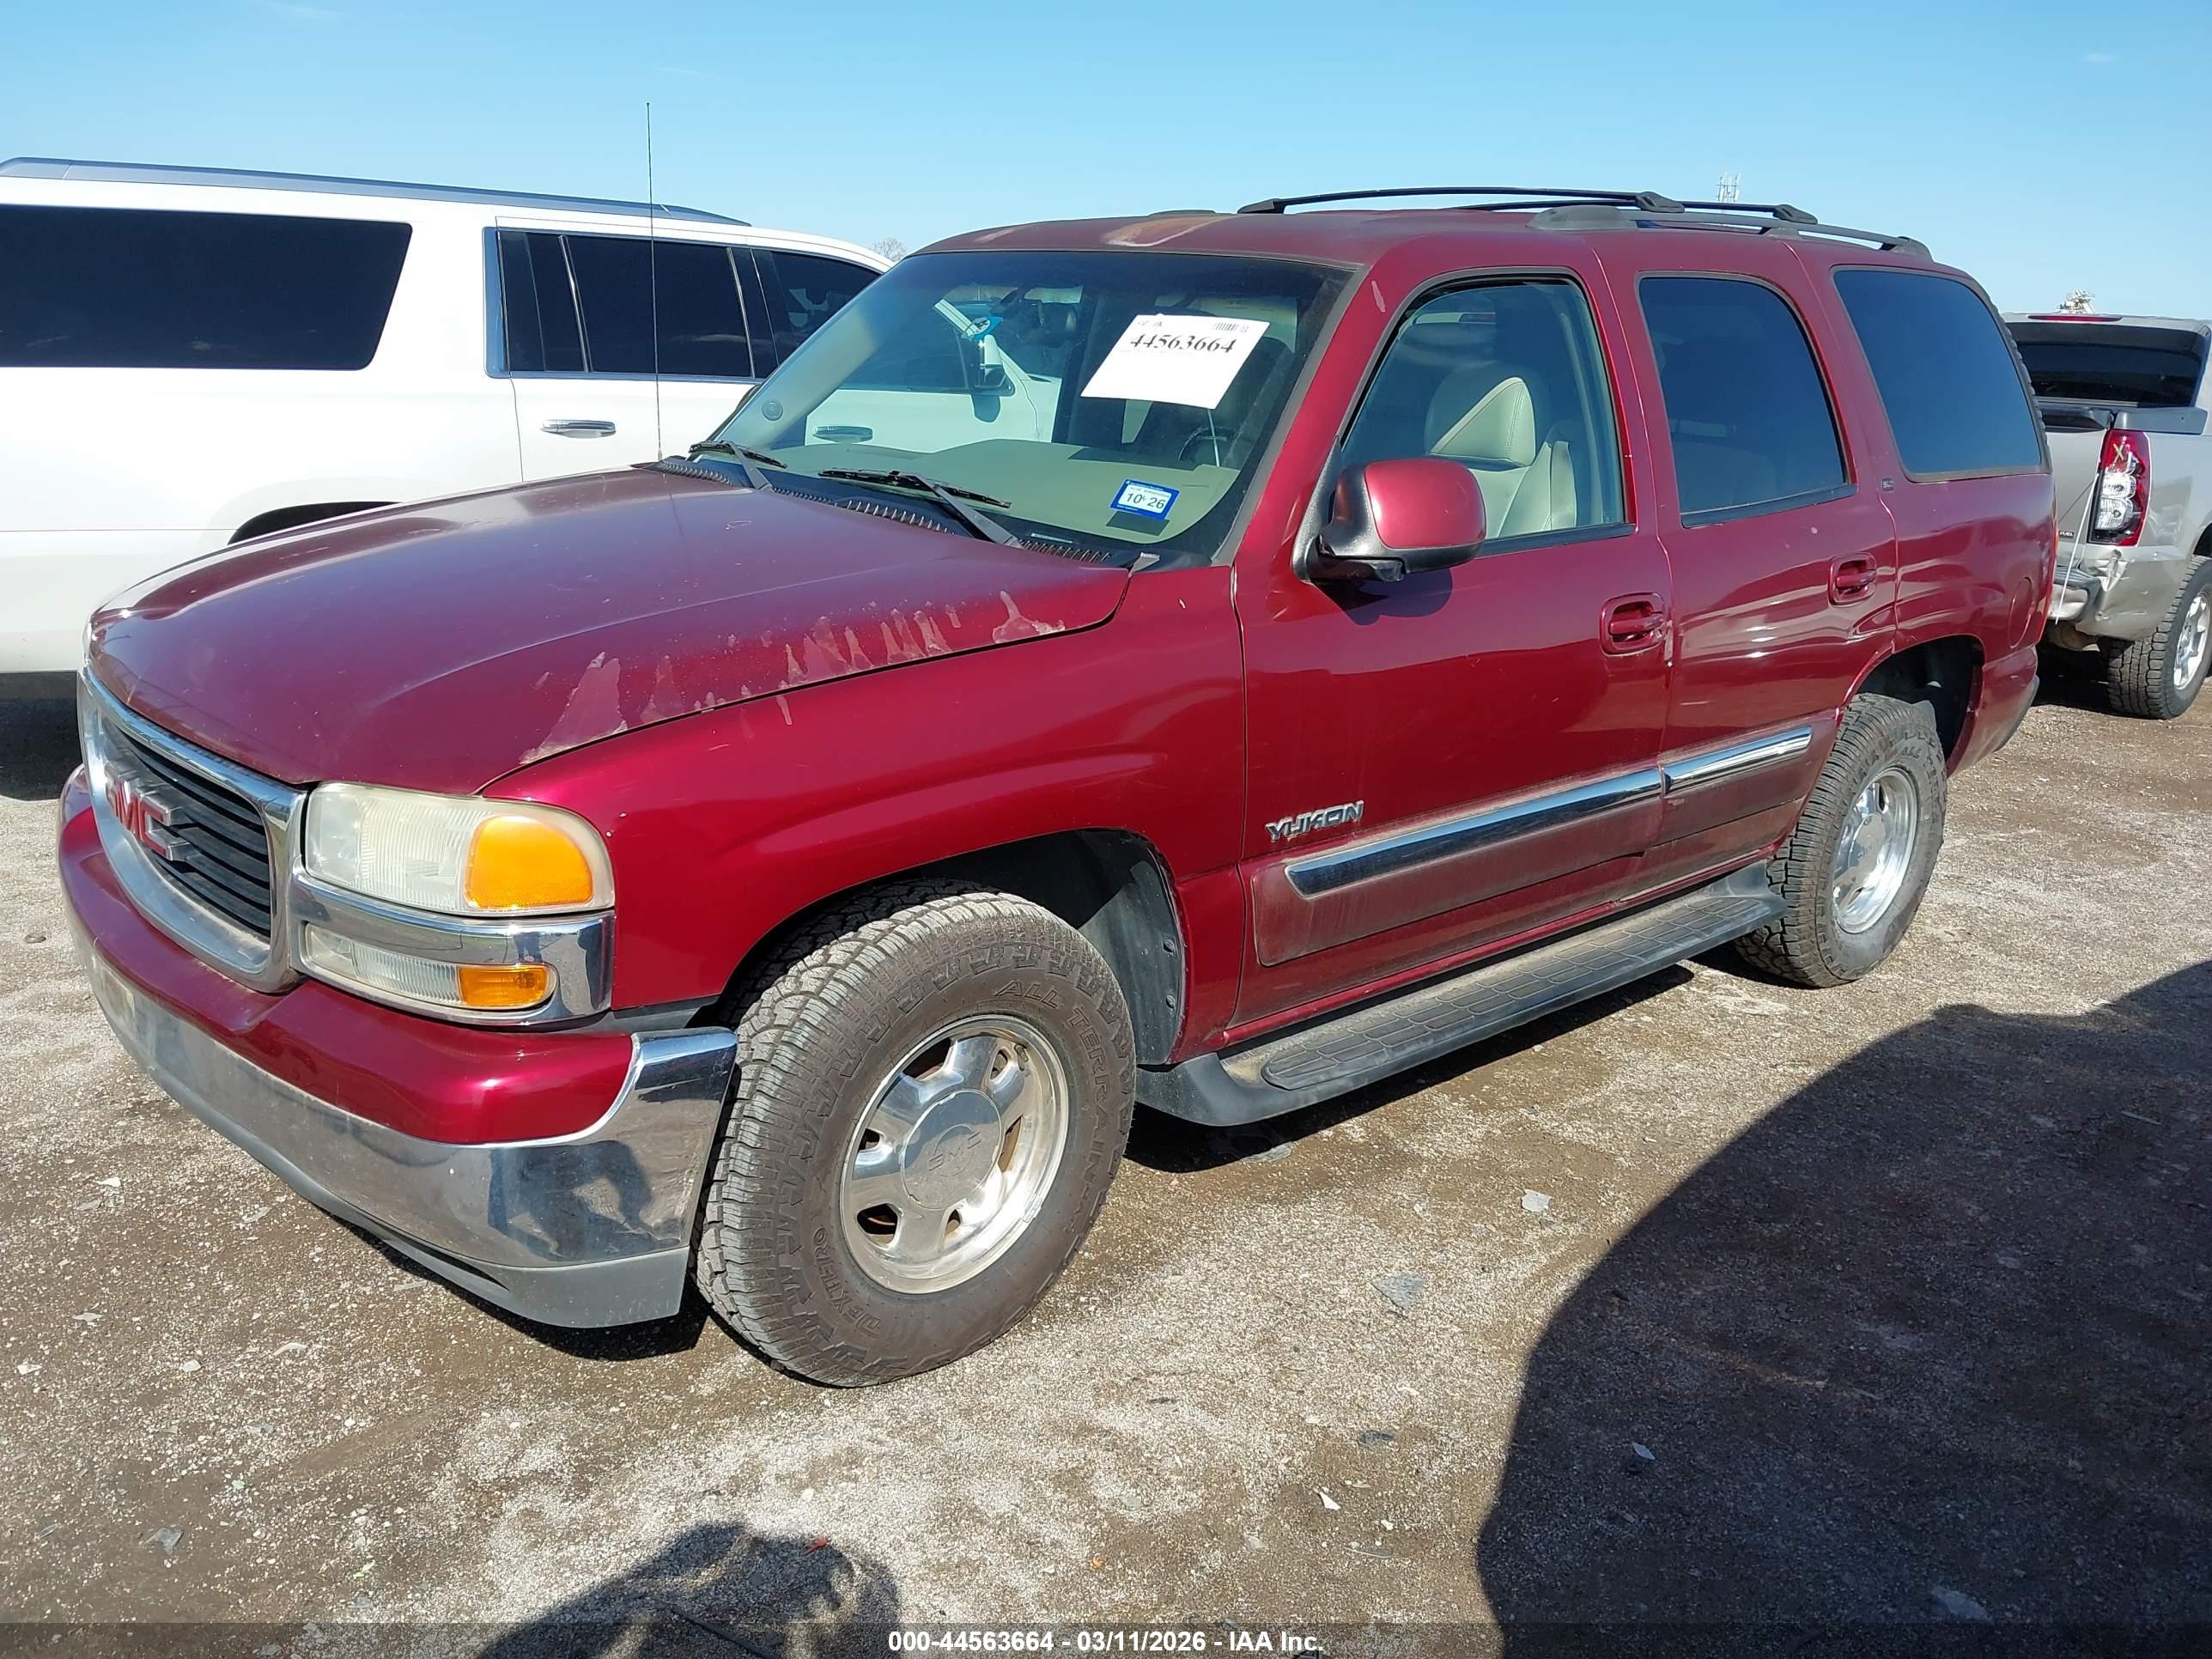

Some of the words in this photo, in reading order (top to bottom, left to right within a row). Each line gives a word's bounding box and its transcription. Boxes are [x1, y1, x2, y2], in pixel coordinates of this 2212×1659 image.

[1129, 333, 1237, 354] 44563664
[1127, 493, 1143, 504] 10
[1147, 497, 1166, 509] 26
[1265, 799, 1364, 842] YUKON
[994, 979, 1059, 1009] ALL
[1067, 1006, 1109, 1183] TERRAIN
